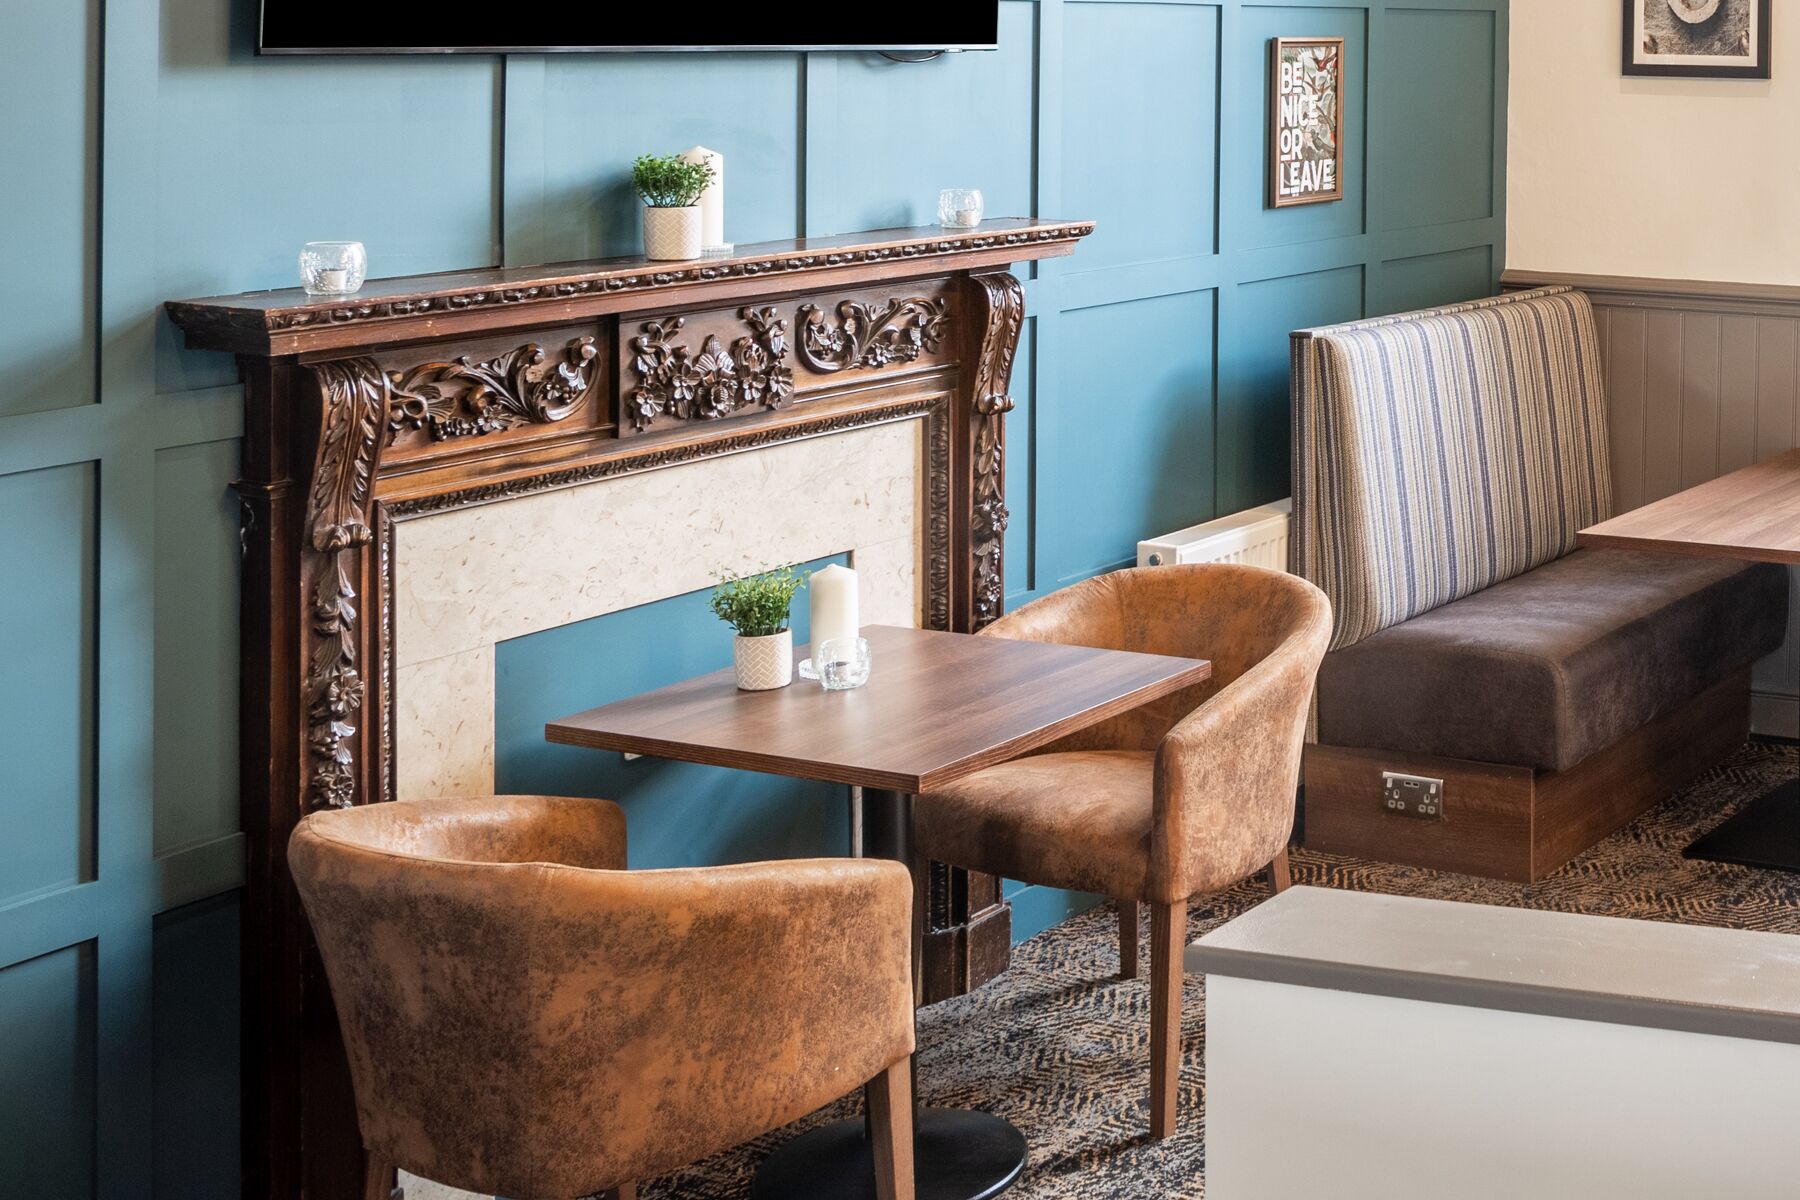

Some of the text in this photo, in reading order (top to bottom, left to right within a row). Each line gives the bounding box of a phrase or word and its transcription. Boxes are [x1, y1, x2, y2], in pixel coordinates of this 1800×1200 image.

[1281, 62, 1303, 94] BE
[1281, 95, 1318, 127] NICE
[1281, 128, 1302, 161] OR
[1280, 159, 1332, 195] LEAVE
